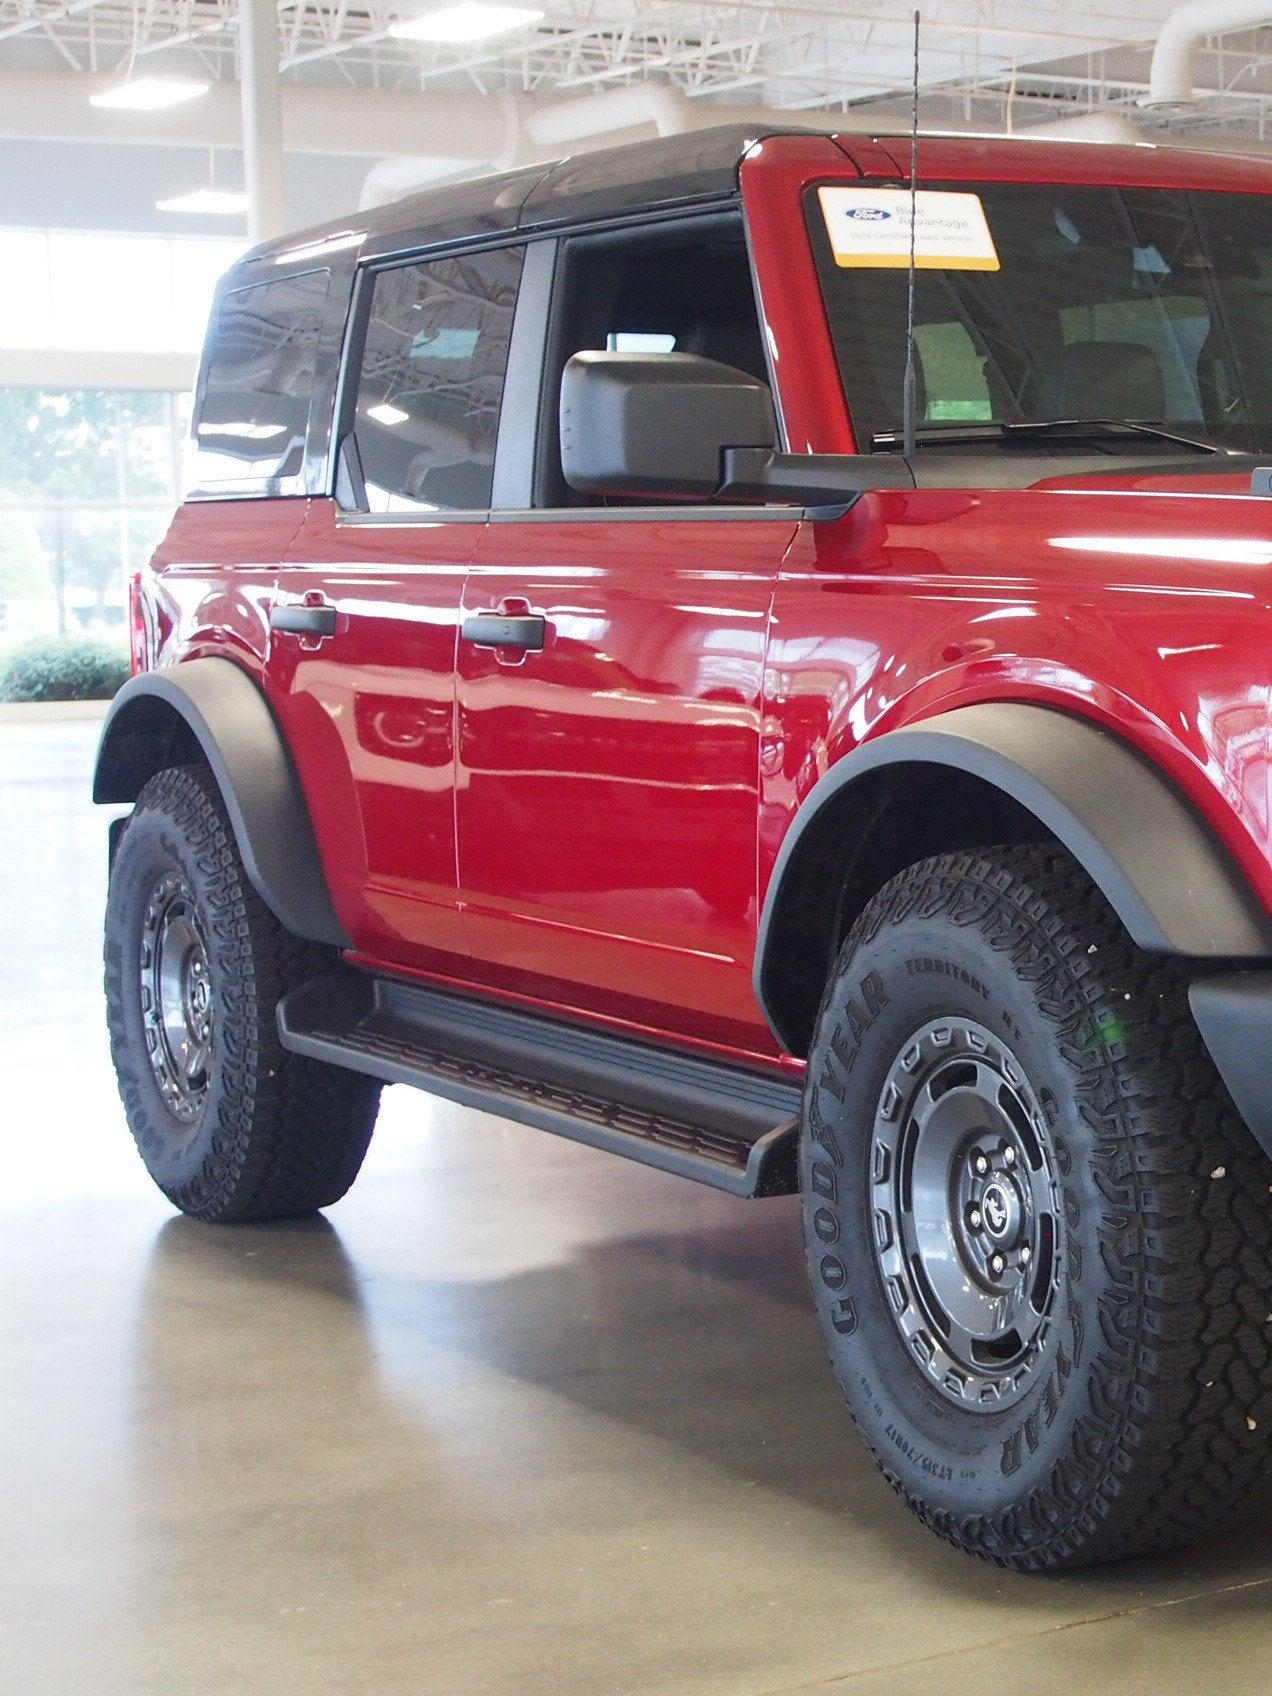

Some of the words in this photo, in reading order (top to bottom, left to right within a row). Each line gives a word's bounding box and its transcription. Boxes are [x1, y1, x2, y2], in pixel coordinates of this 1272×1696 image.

[852, 208, 886, 220] Ford
[896, 206, 925, 216] Blue
[900, 218, 969, 229] Advantage
[904, 957, 990, 1001] TERRITORY
[810, 968, 891, 1335] GOODYEAR
[885, 1424, 953, 1481] LT315/70R17
